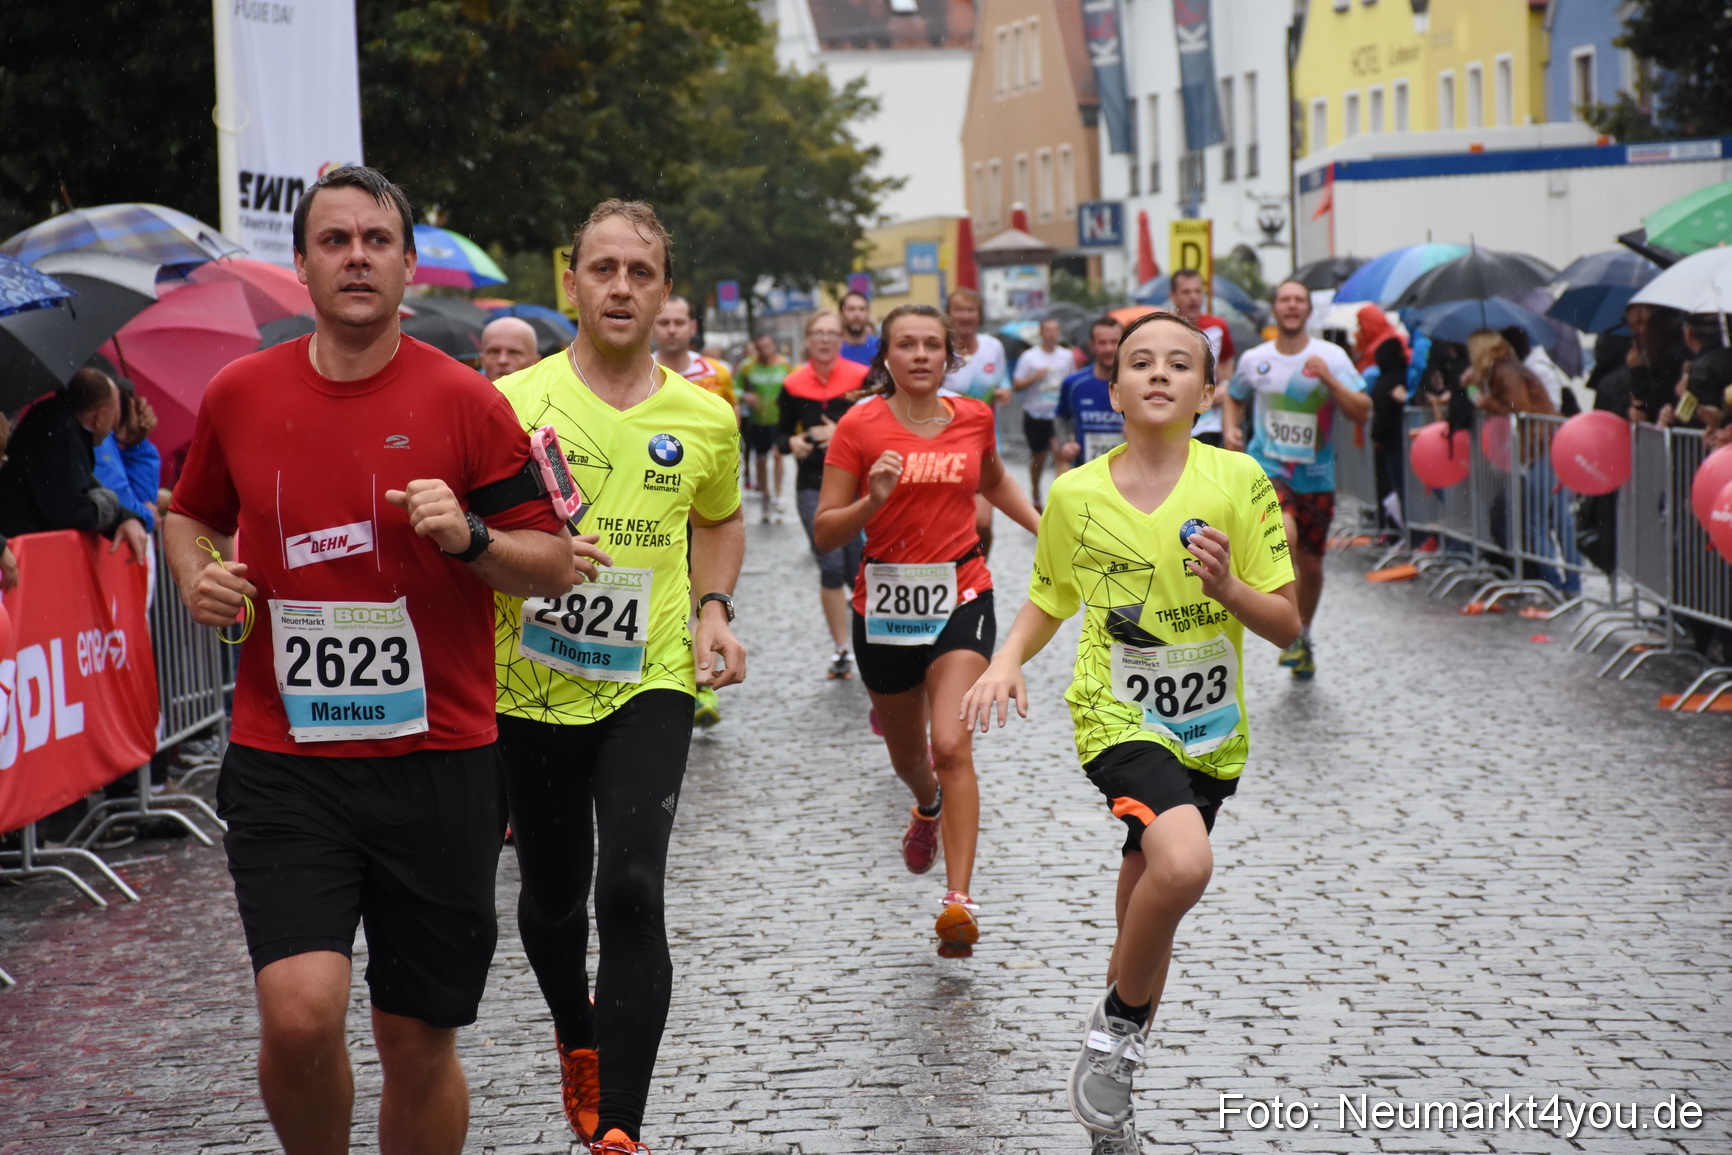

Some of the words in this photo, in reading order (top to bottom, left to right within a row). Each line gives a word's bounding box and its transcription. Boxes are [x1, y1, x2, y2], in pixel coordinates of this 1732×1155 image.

[1181, 241, 1202, 270] D
[1270, 422, 1313, 446] 3059
[644, 469, 682, 487] Partl
[901, 451, 967, 485] NIKE
[643, 483, 680, 494] Neumarkt
[597, 517, 623, 532] THE
[626, 519, 660, 534] NEXT
[311, 534, 349, 554] DEHN
[608, 532, 632, 546] 100
[635, 533, 671, 548] YEARS
[584, 570, 643, 588] OCK
[875, 583, 949, 616] 2802
[281, 616, 325, 626] NeuerMarkt
[334, 607, 405, 624] BOCK
[534, 594, 639, 641] 2824
[1155, 609, 1183, 624] THE
[1182, 602, 1211, 620] NEXT
[1171, 621, 1191, 634] 100
[1191, 609, 1229, 628] YEARS
[886, 621, 937, 634] Veronika
[286, 635, 410, 688] 2623
[550, 637, 612, 666] Thomas
[1167, 639, 1227, 664] BOCK
[1127, 664, 1228, 718] 2823
[311, 701, 386, 721] Markus
